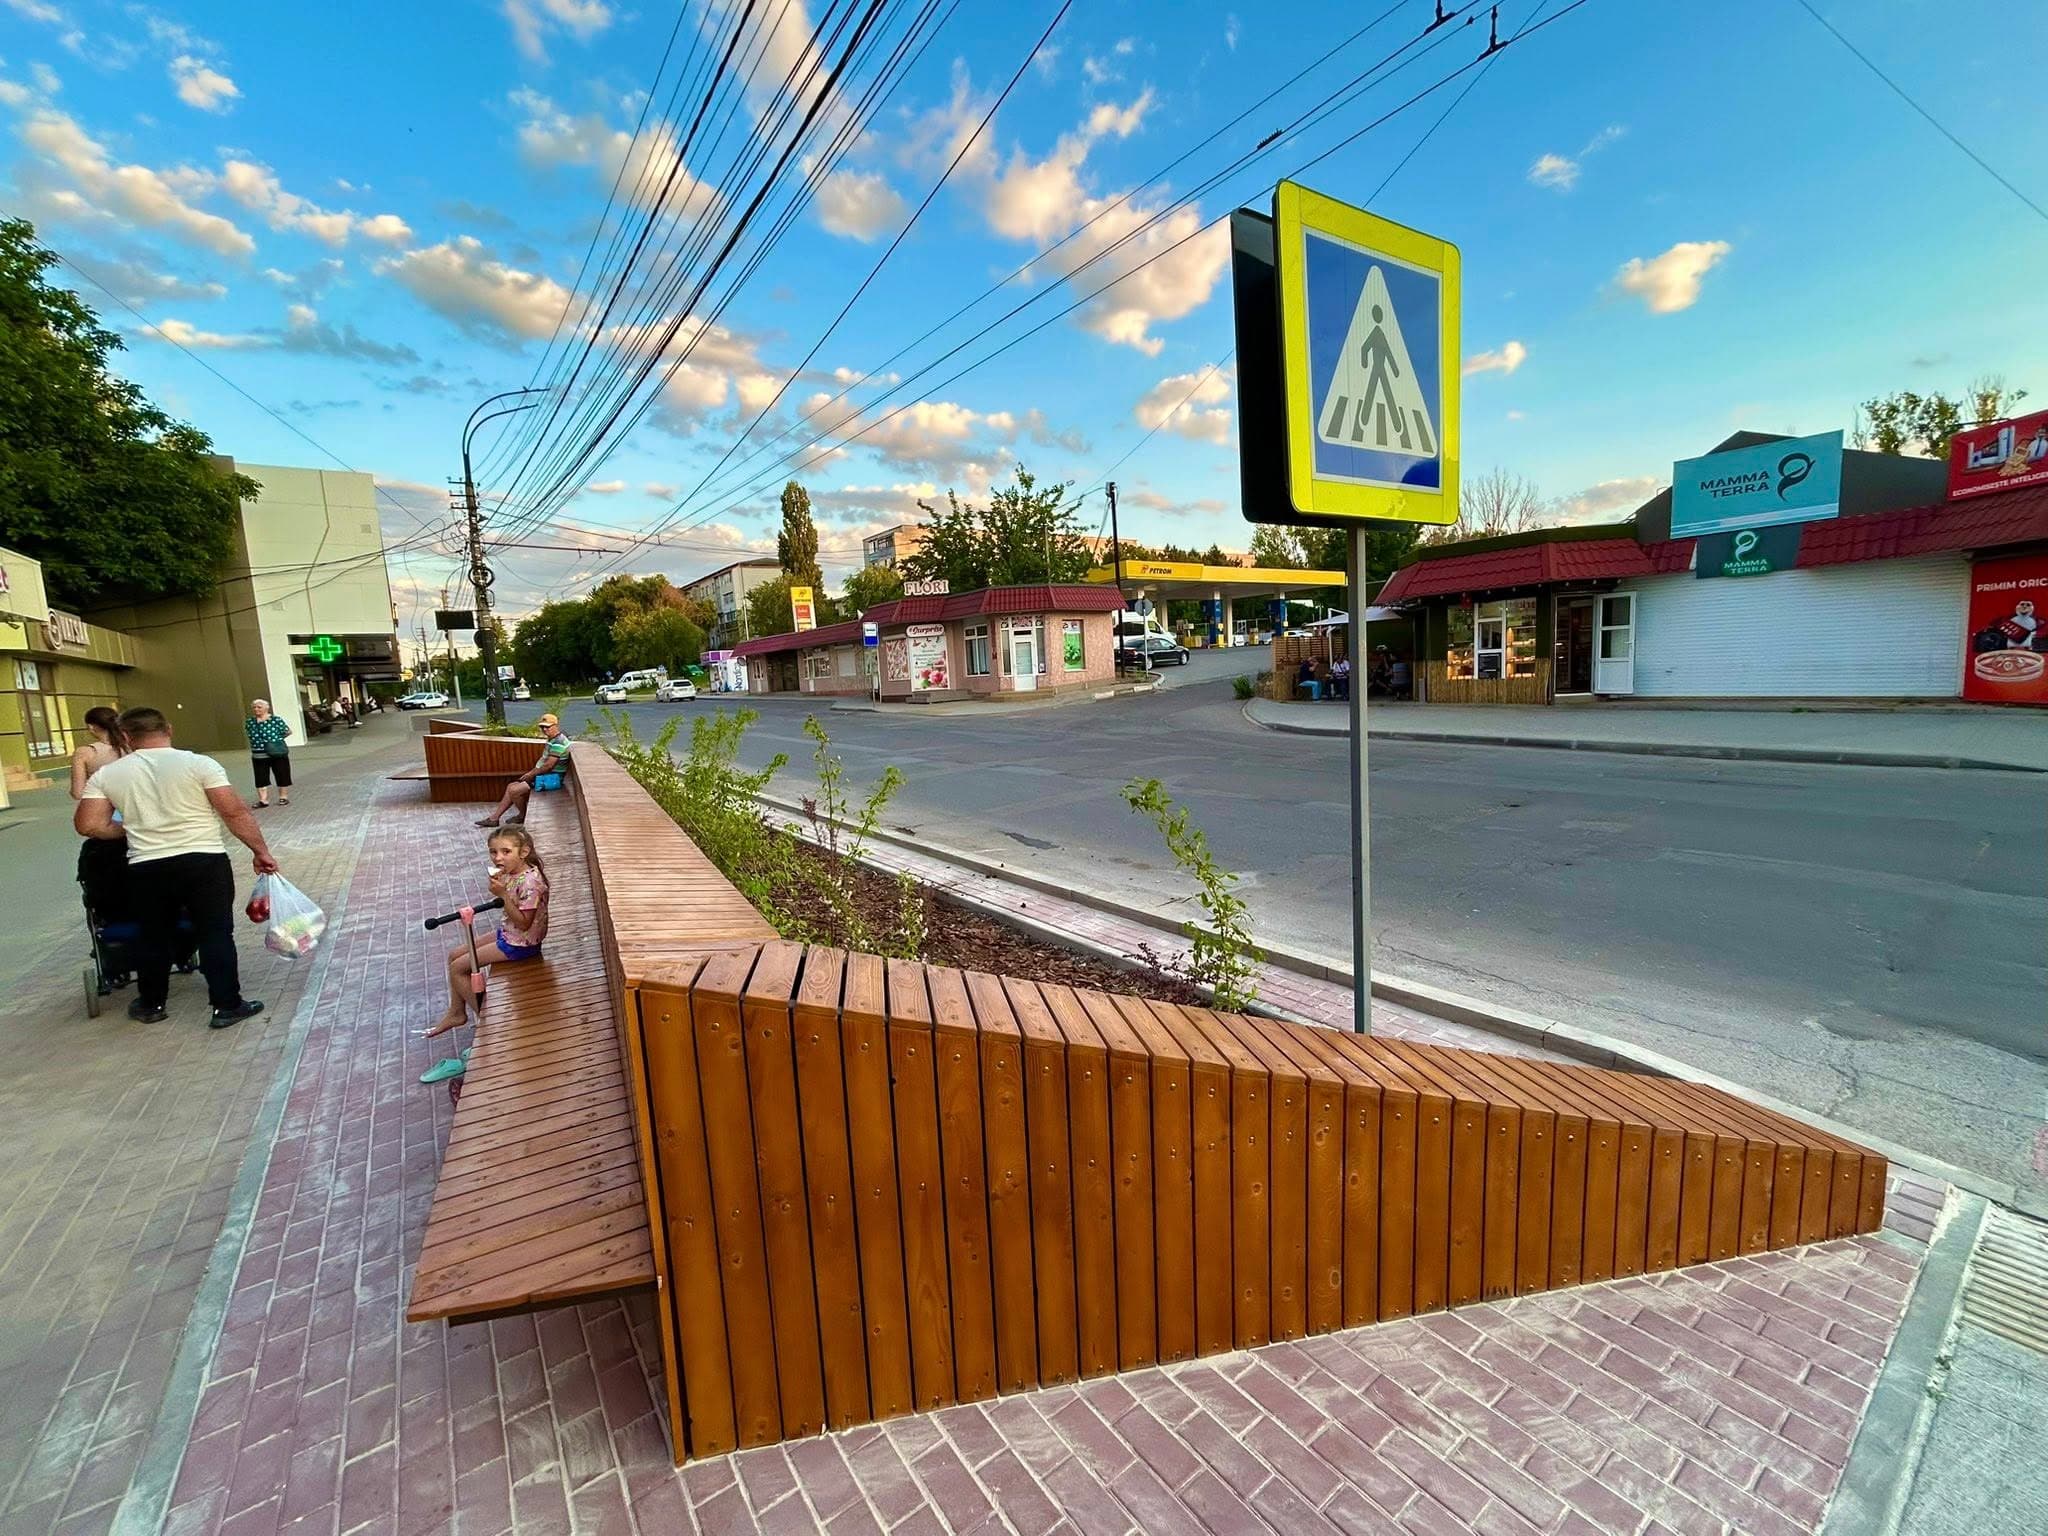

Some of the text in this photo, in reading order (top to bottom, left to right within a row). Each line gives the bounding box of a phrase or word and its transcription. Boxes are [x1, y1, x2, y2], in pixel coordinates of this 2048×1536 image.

[1700, 470, 1769, 490] MAMMA
[1710, 482, 1769, 498] TERRA
[1724, 558, 1768, 569] MAMMA
[1149, 567, 1172, 575] PETROM
[1731, 565, 1767, 574] TERRA
[905, 580, 949, 595] FLORI
[1976, 581, 2016, 592] PRIMIM
